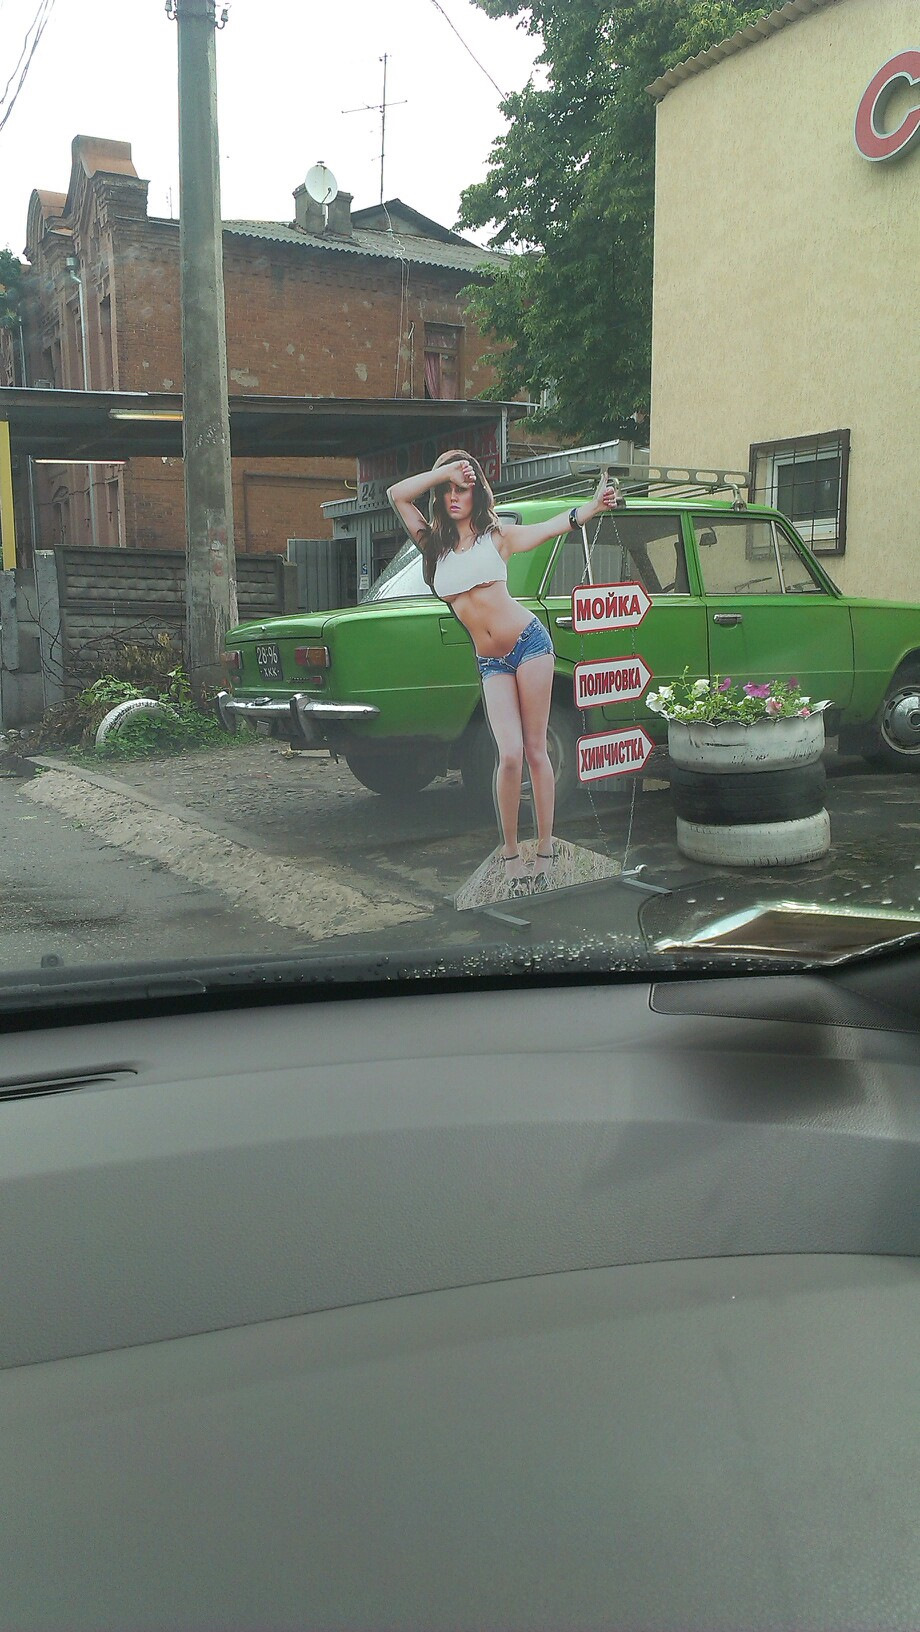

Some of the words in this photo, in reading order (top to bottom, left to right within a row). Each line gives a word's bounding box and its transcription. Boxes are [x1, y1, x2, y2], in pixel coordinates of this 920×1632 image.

[576, 592, 641, 621] МОЙКА
[579, 667, 641, 697] ПОЛИРОВКА
[580, 738, 644, 772] ХИМЧИСТКА
